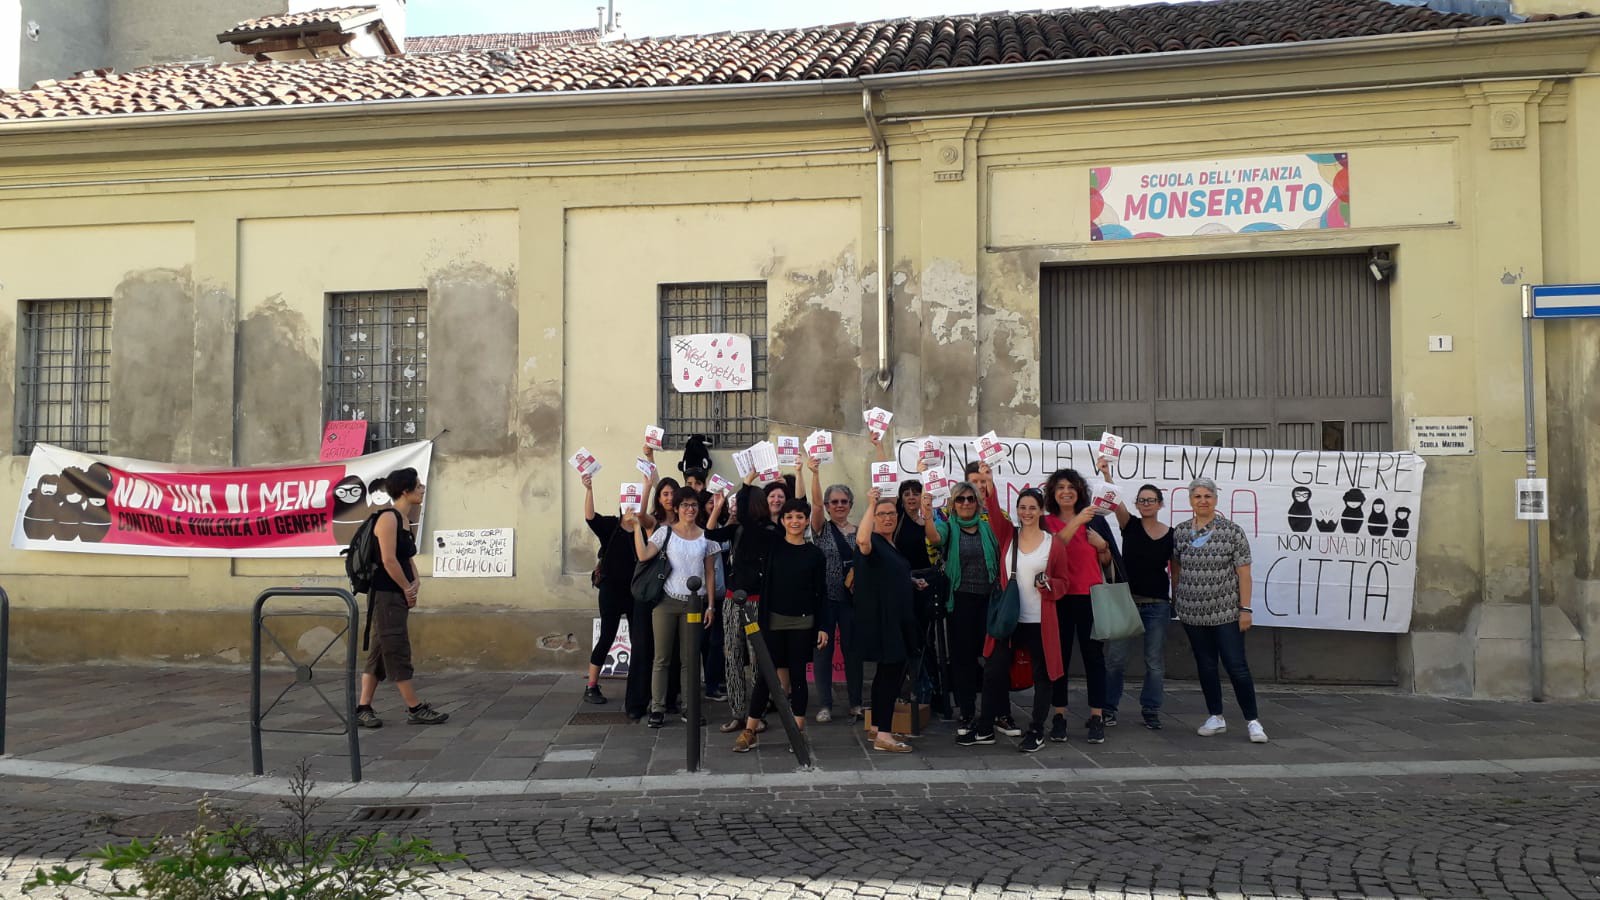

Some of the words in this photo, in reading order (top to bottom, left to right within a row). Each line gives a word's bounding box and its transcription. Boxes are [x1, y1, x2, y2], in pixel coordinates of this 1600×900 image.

[1140, 172, 1194, 189] SCUOLA
[1123, 182, 1323, 222] MONSERRATO
[1438, 337, 1443, 349] 1
[1041, 441, 1074, 475] LA
[1248, 449, 1276, 483] DI
[1291, 451, 1414, 493] GENERE
[113, 477, 164, 510] NON
[166, 483, 217, 514] UNA
[225, 483, 249, 514] DI
[259, 479, 331, 513] MENO
[117, 511, 164, 535] CONTRO
[168, 514, 186, 536] LA
[187, 516, 252, 537] VIOLENZA
[256, 516, 272, 536] DI
[275, 512, 328, 535] GENERE
[1277, 535, 1312, 552] NON
[1319, 536, 1350, 555] UNA
[1354, 537, 1370, 556] DI
[1371, 537, 1413, 561] MENO
